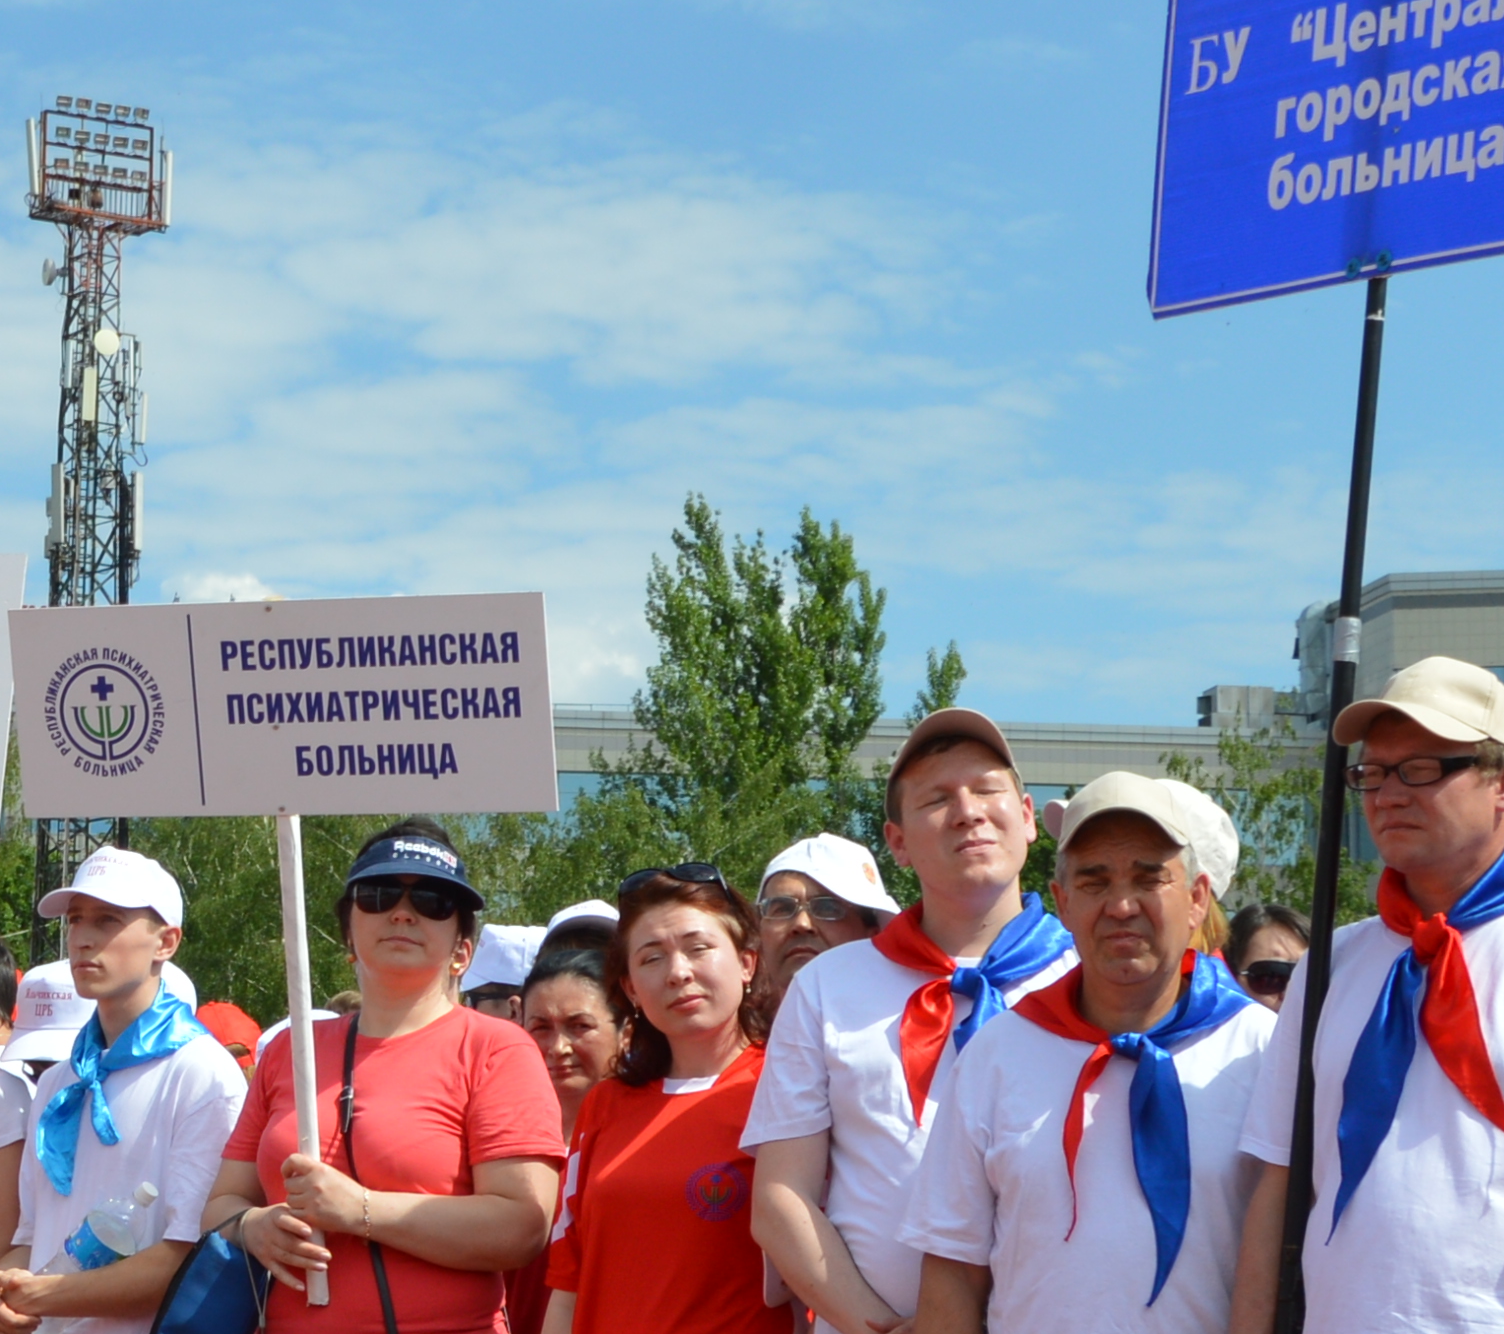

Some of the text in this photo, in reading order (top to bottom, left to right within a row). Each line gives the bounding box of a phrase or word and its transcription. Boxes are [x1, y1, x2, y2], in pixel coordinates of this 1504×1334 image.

[1185, 26, 1251, 95] БУ
[220, 631, 520, 672] РЕСПУБЛИКАНСКАЯ
[44, 647, 165, 757] РЕСПУБЛИКАНСКАЯ ПСИХИАТРИЧЕСКАЯ
[226, 686, 522, 725] ПСИХИАТРИЧЕСКАЯ
[73, 755, 144, 777] БОЛЬНИЦА
[295, 742, 459, 780] БОЛЬНИЦА
[34, 1003, 54, 1017] ЦРБ
